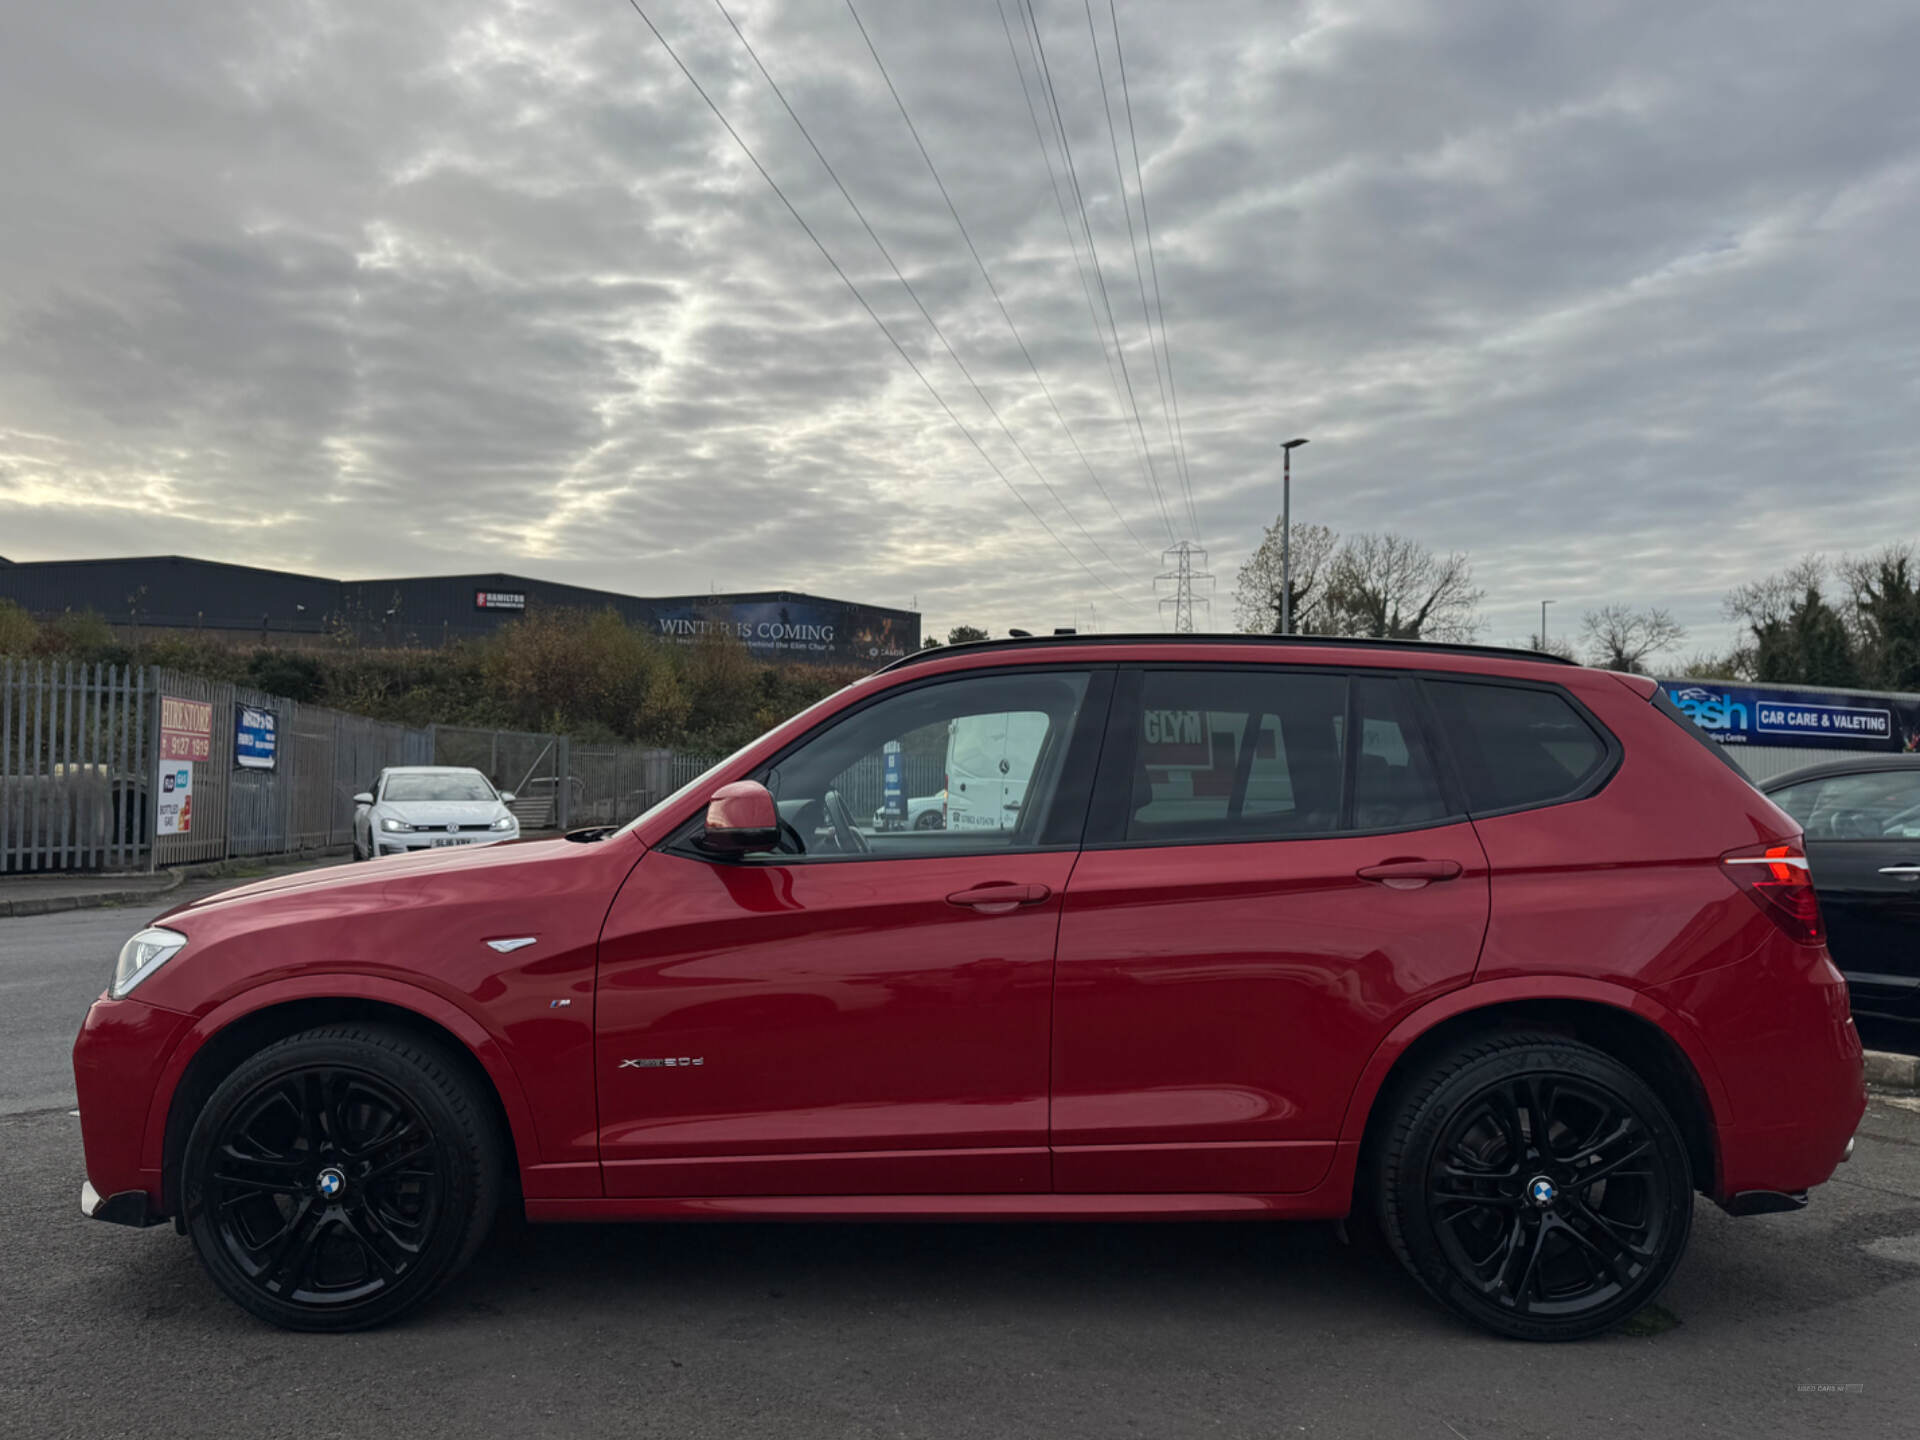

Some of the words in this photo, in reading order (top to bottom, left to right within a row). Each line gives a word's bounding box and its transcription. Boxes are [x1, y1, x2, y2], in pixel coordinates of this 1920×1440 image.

[737, 622, 753, 638] IS
[758, 622, 834, 642] COMING
[1760, 710, 1785, 725] CAR
[1787, 712, 1818, 727] CARE
[1821, 714, 1830, 727] &
[1832, 715, 1886, 731] VALETING
[171, 736, 190, 755] 9127
[192, 738, 209, 756] 1919
[1725, 733, 1747, 742] Centre
